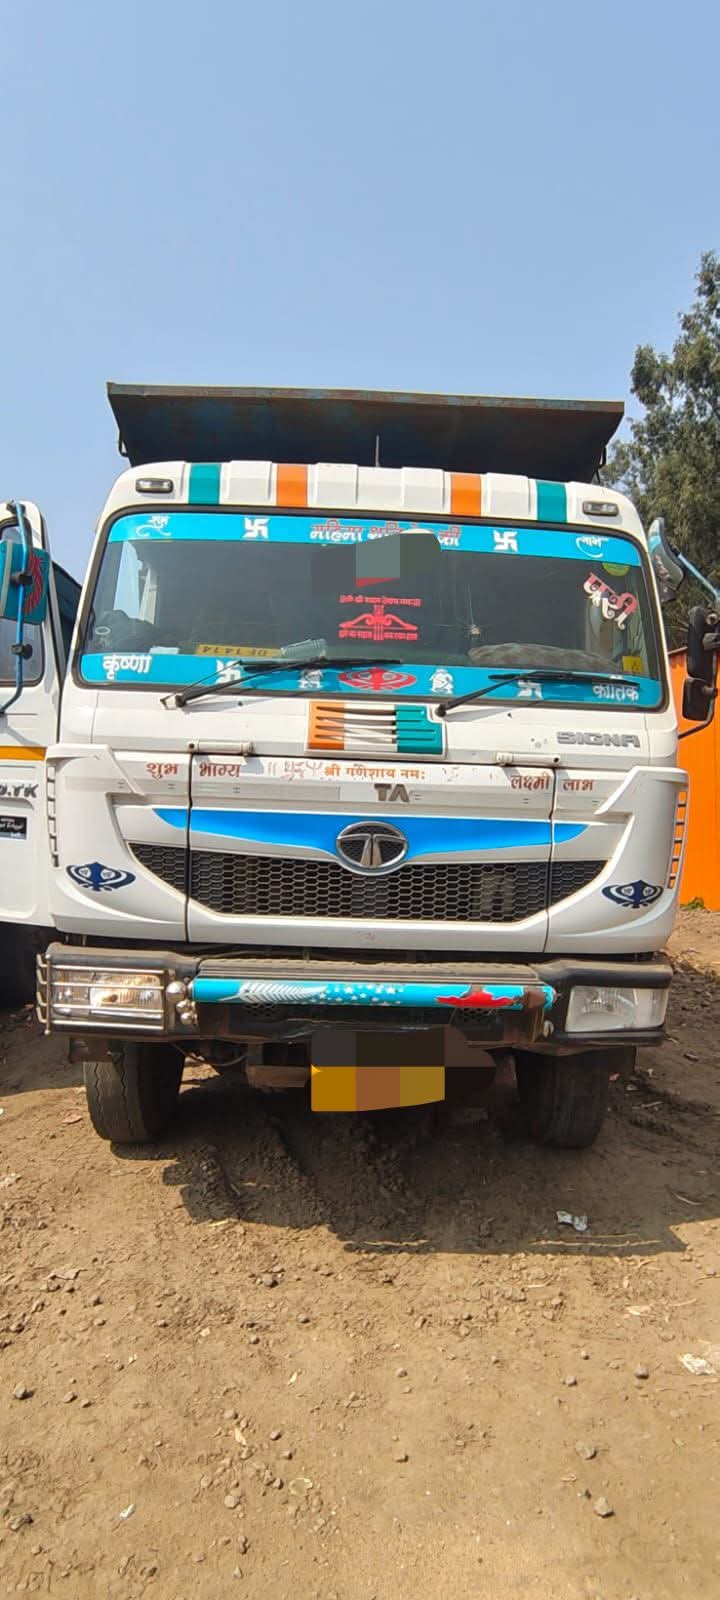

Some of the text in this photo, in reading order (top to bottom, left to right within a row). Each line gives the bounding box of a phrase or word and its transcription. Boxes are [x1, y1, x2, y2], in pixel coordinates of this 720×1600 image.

[103, 655, 151, 680] कृष्णा
[557, 731, 641, 748] SIGNA
[146, 762, 178, 780] शुभ
[374, 784, 410, 802] TA
[562, 779, 594, 792] लाभ
